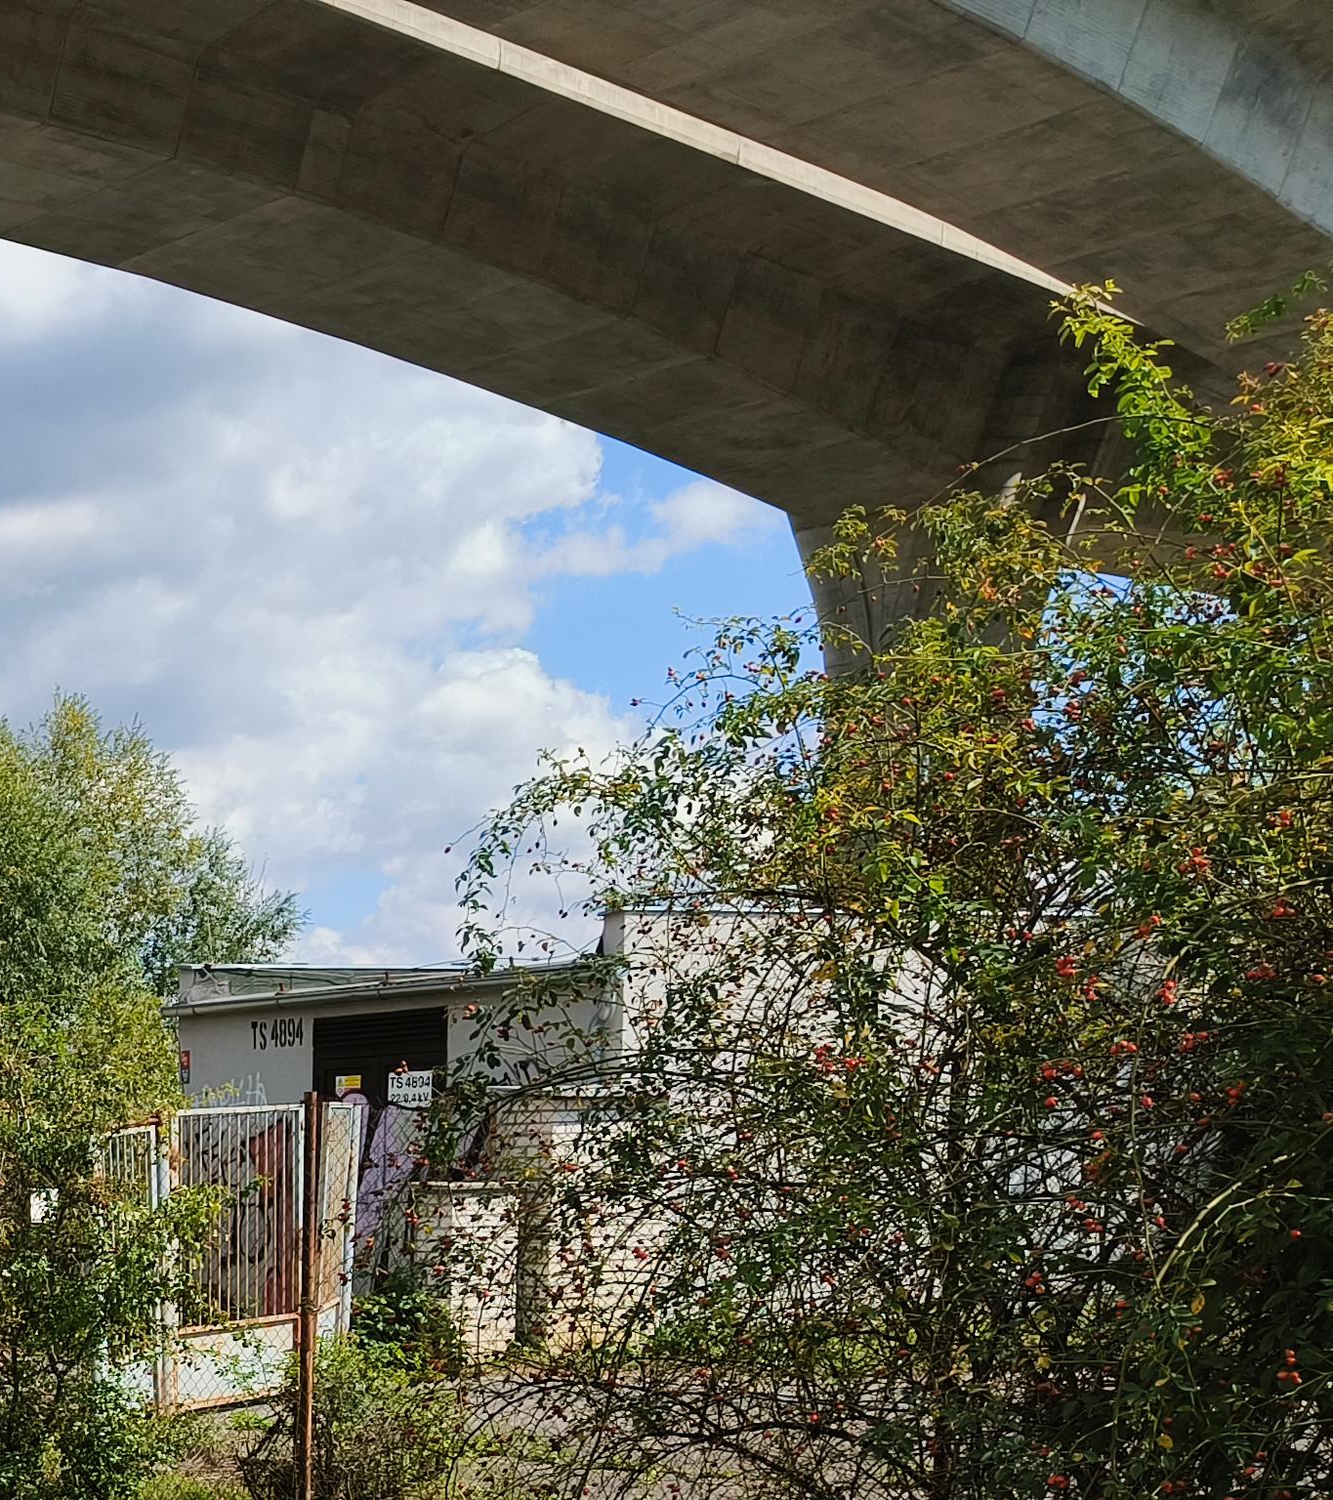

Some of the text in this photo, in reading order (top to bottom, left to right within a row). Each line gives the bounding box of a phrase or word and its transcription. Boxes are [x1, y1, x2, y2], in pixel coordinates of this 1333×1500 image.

[251, 1017, 304, 1051] TS 4894
[390, 1076, 404, 1089] TS
